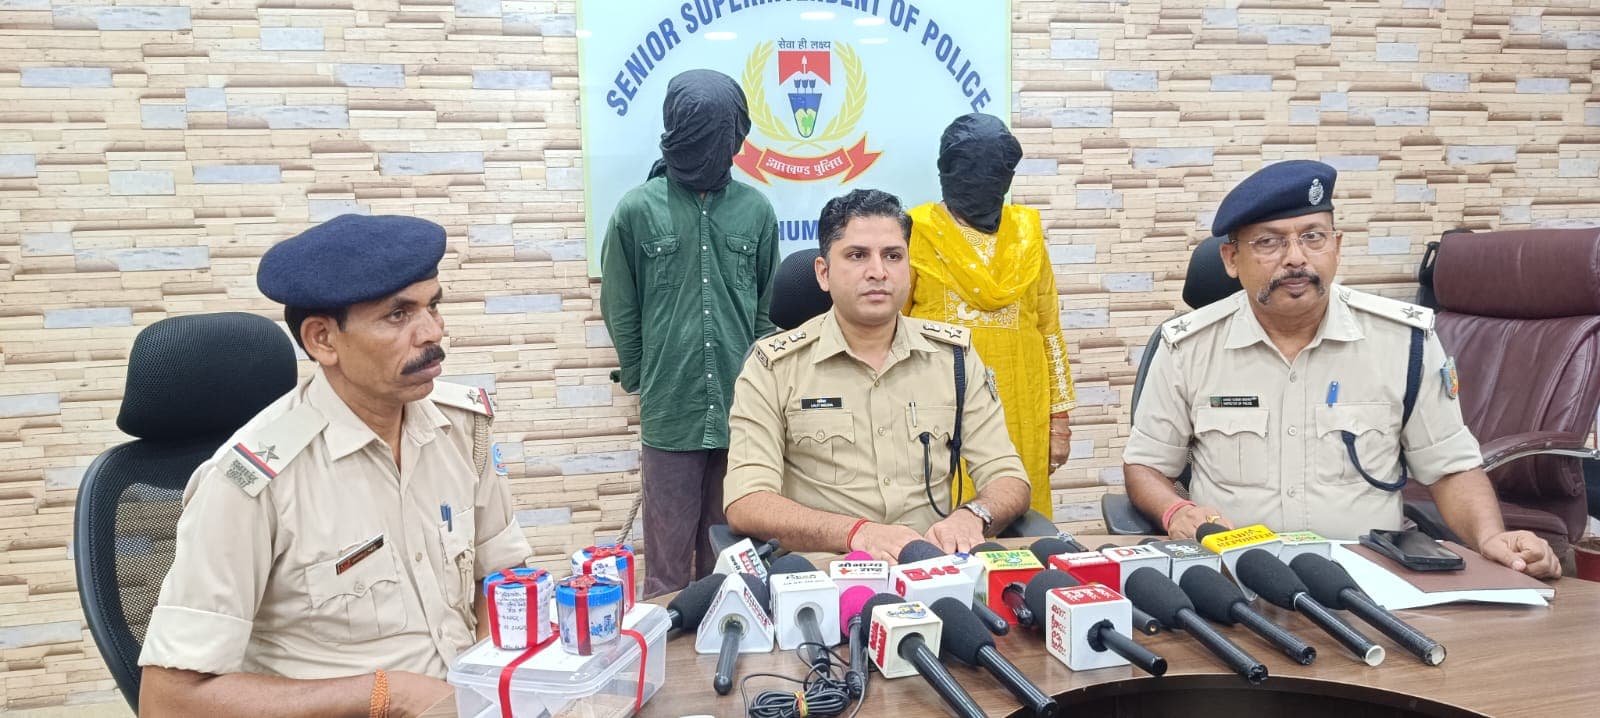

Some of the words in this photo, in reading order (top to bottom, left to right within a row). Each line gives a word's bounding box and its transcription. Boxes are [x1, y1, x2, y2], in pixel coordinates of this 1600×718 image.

[777, 38, 795, 50] सेवा
[797, 37, 808, 50] ही
[810, 39, 831, 50] लक्ष्य
[606, 17, 681, 116] SENIOR
[889, 0, 921, 32] OF
[921, 19, 992, 113] POLICE
[813, 156, 844, 176] पुलिस
